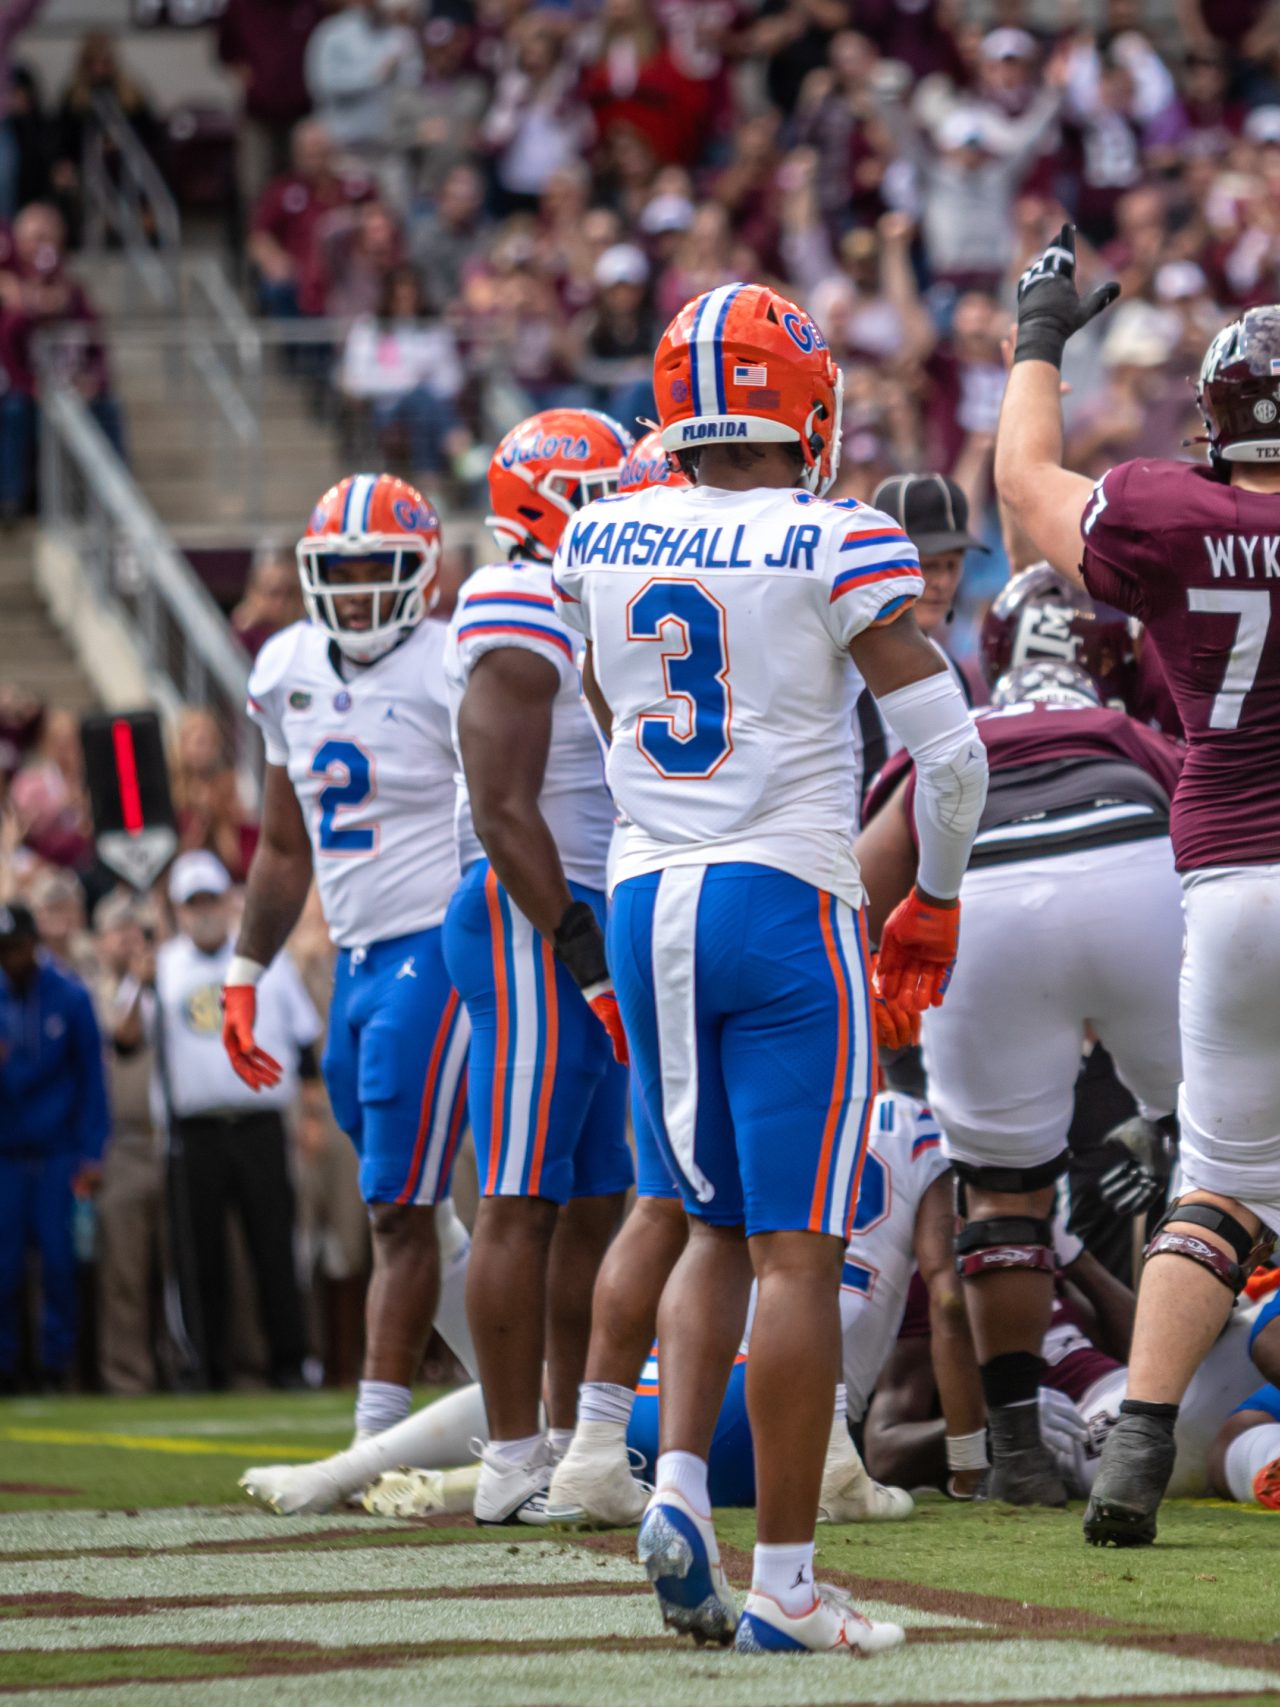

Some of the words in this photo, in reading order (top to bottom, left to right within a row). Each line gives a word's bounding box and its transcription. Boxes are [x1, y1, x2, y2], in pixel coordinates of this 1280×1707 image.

[682, 421, 748, 442] FLORIDA
[618, 456, 671, 487] ators
[566, 520, 752, 568] MARSHALL
[764, 523, 823, 571] JR
[626, 577, 734, 781] 3
[306, 734, 381, 858] 2
